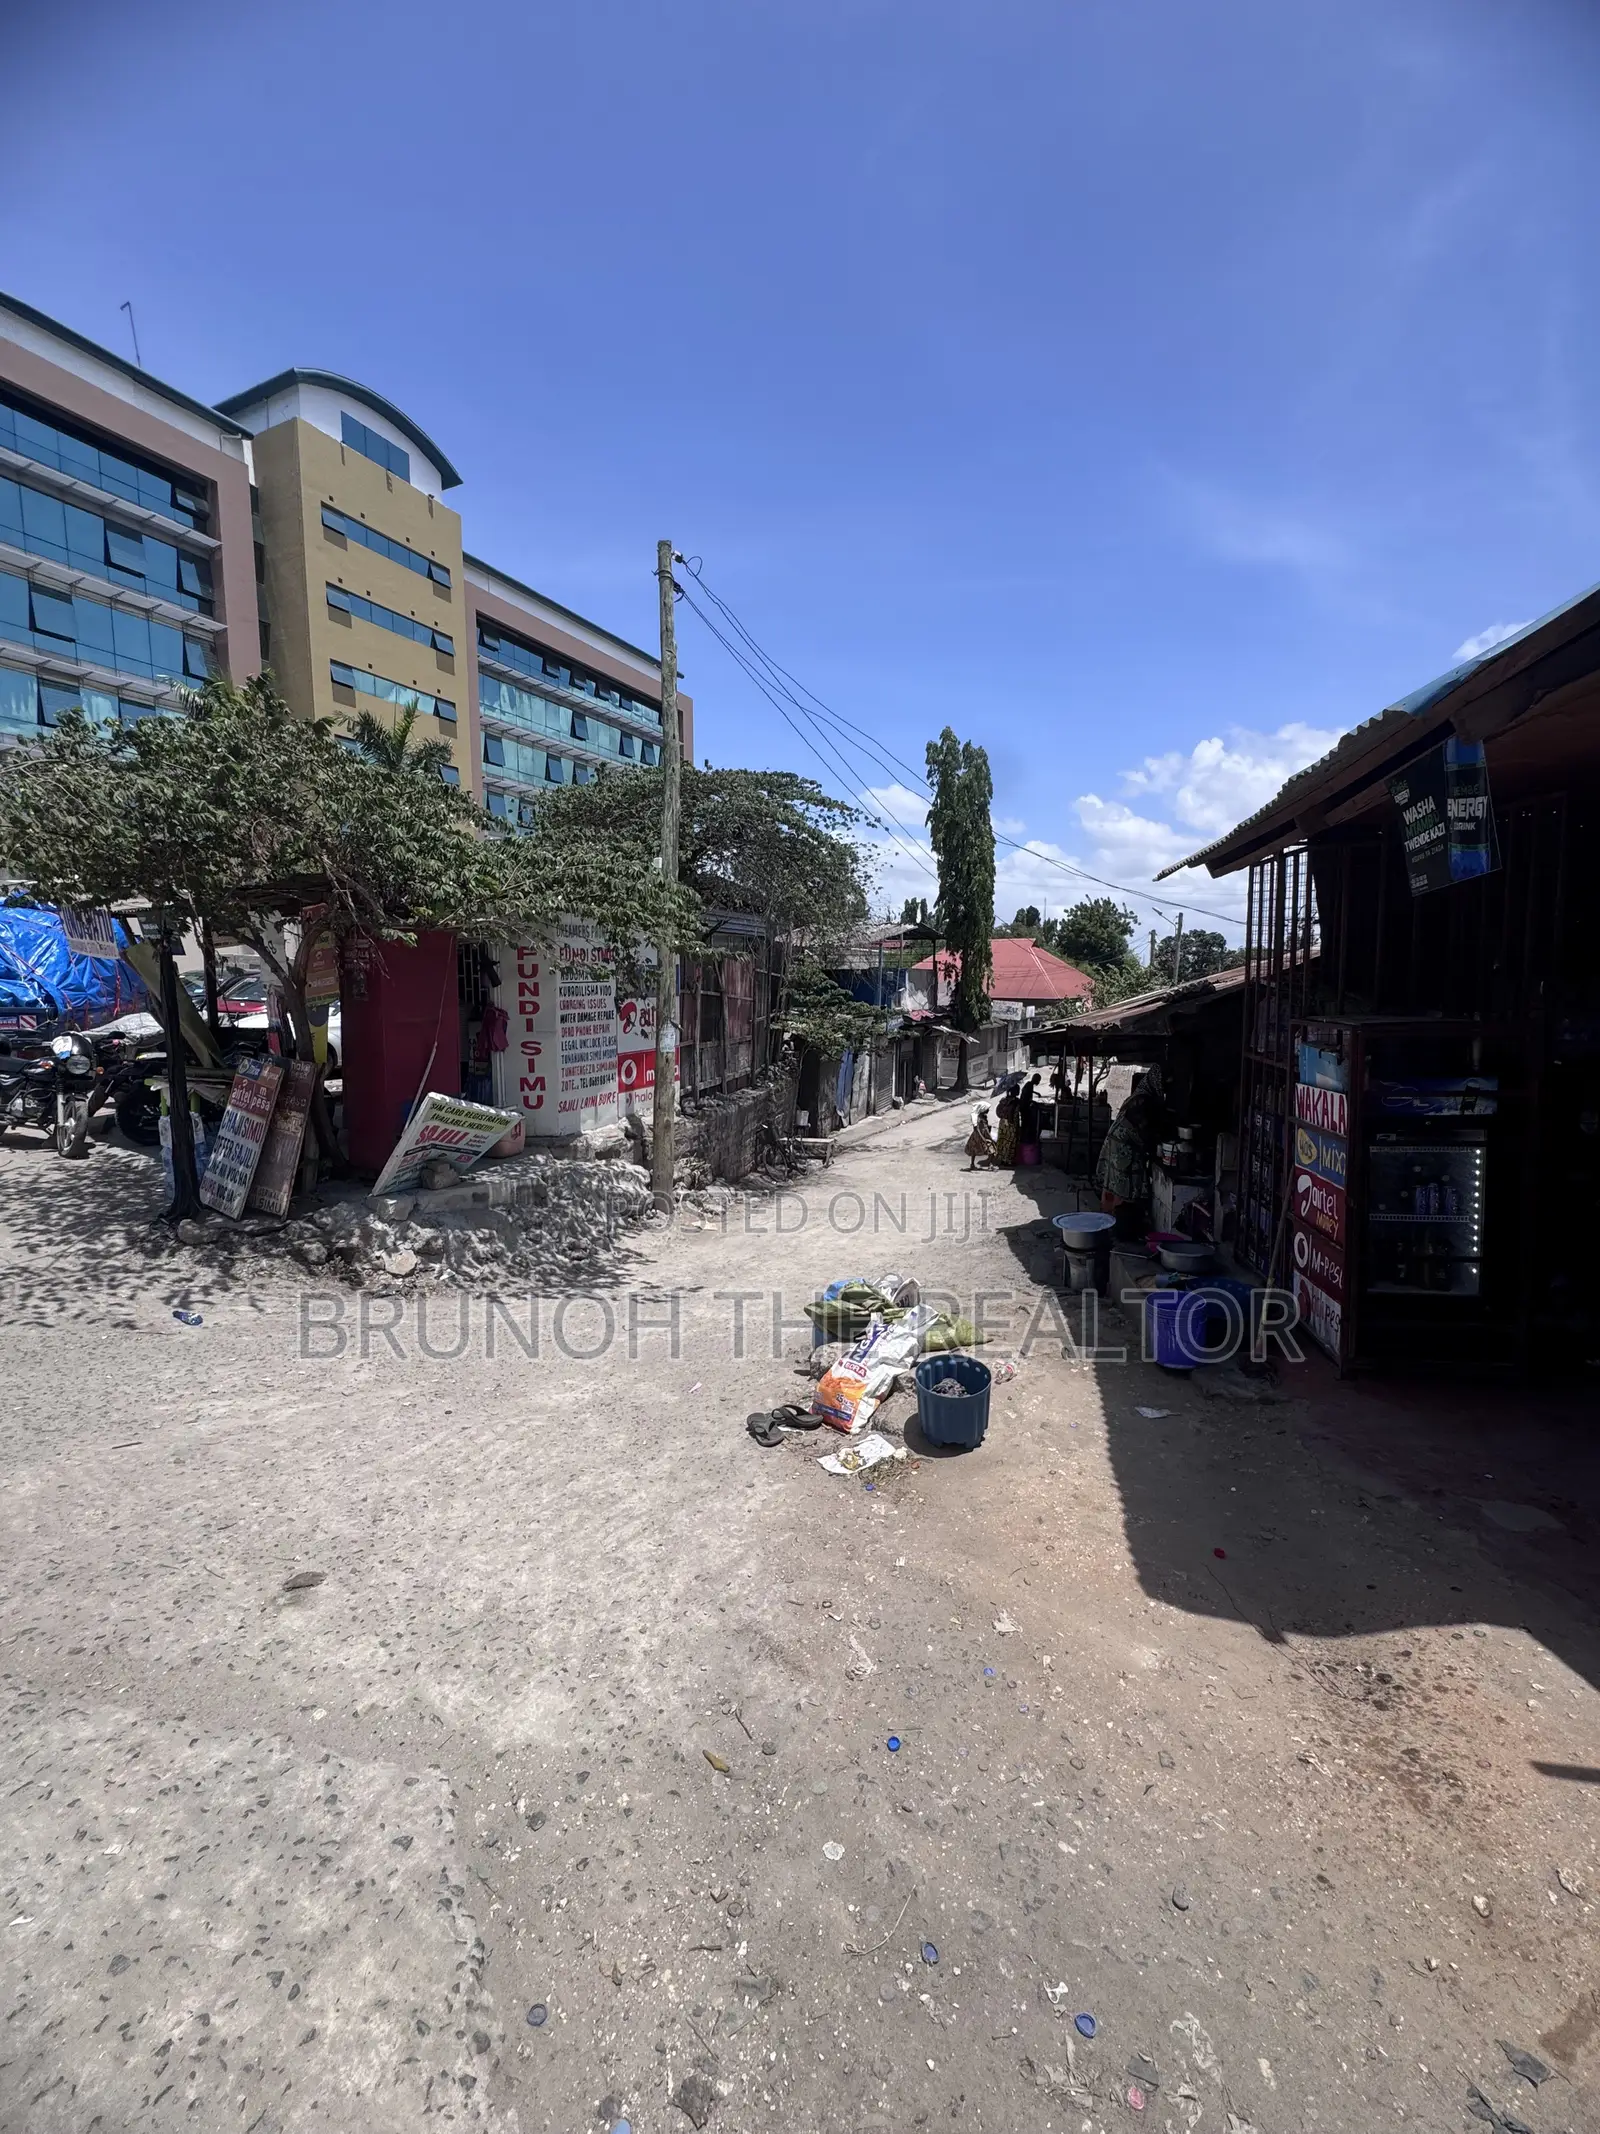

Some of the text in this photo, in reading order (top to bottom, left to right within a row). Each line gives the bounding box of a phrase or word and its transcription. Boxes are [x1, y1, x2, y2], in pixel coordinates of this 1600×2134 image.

[1403, 796, 1436, 825] WASHA
[1447, 796, 1488, 820] ENERGY
[1430, 822, 1446, 839] KAZI
[1454, 822, 1476, 831] DRINK
[559, 946, 589, 962] FUNDI
[588, 998, 607, 1009] ISSUES
[517, 946, 546, 1110] FUNDI SIMU
[560, 1012, 576, 1024] WATER
[561, 1040, 579, 1052] LEGAL
[580, 1077, 589, 1089] TEL
[232, 1085, 252, 1104] airtel
[250, 1096, 271, 1112] pesa
[558, 1091, 617, 1114] SAJILI LAINI BURE
[430, 1102, 511, 1126] SIM CARD REGISTRATION
[430, 1113, 467, 1128] AVAILABLE
[1296, 1085, 1346, 1136] WAKALA
[220, 1109, 245, 1136] CHAJI
[241, 1117, 265, 1143] SIMU
[415, 1125, 470, 1146] SAJILI
[231, 1142, 257, 1170] SAJILI
[1312, 1186, 1338, 1220] airtel
